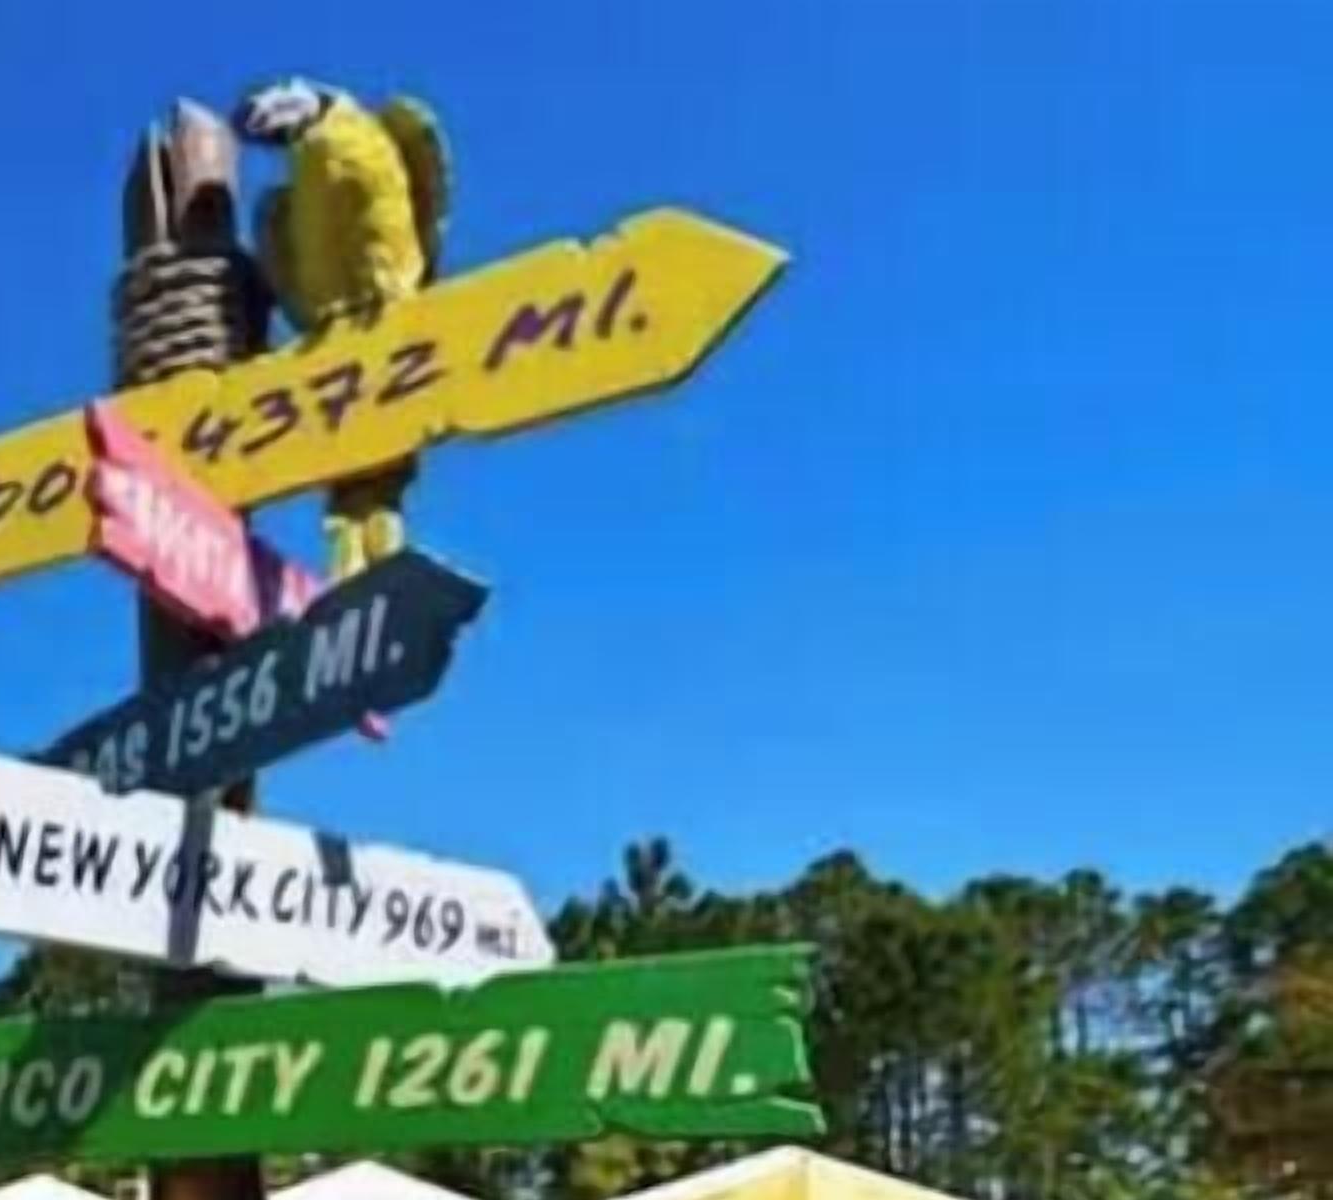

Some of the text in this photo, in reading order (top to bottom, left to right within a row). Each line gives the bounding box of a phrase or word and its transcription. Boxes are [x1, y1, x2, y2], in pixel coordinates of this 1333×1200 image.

[180, 338, 446, 464] 4372
[483, 266, 649, 372] MI.
[165, 649, 279, 771] 1556
[302, 592, 405, 704] MI.
[130, 840, 260, 921] YORK
[271, 860, 374, 937] CITY
[381, 887, 466, 956] 969
[136, 1040, 325, 1119] CITY
[353, 1025, 550, 1109] 1261
[586, 1014, 758, 1100] MI.
